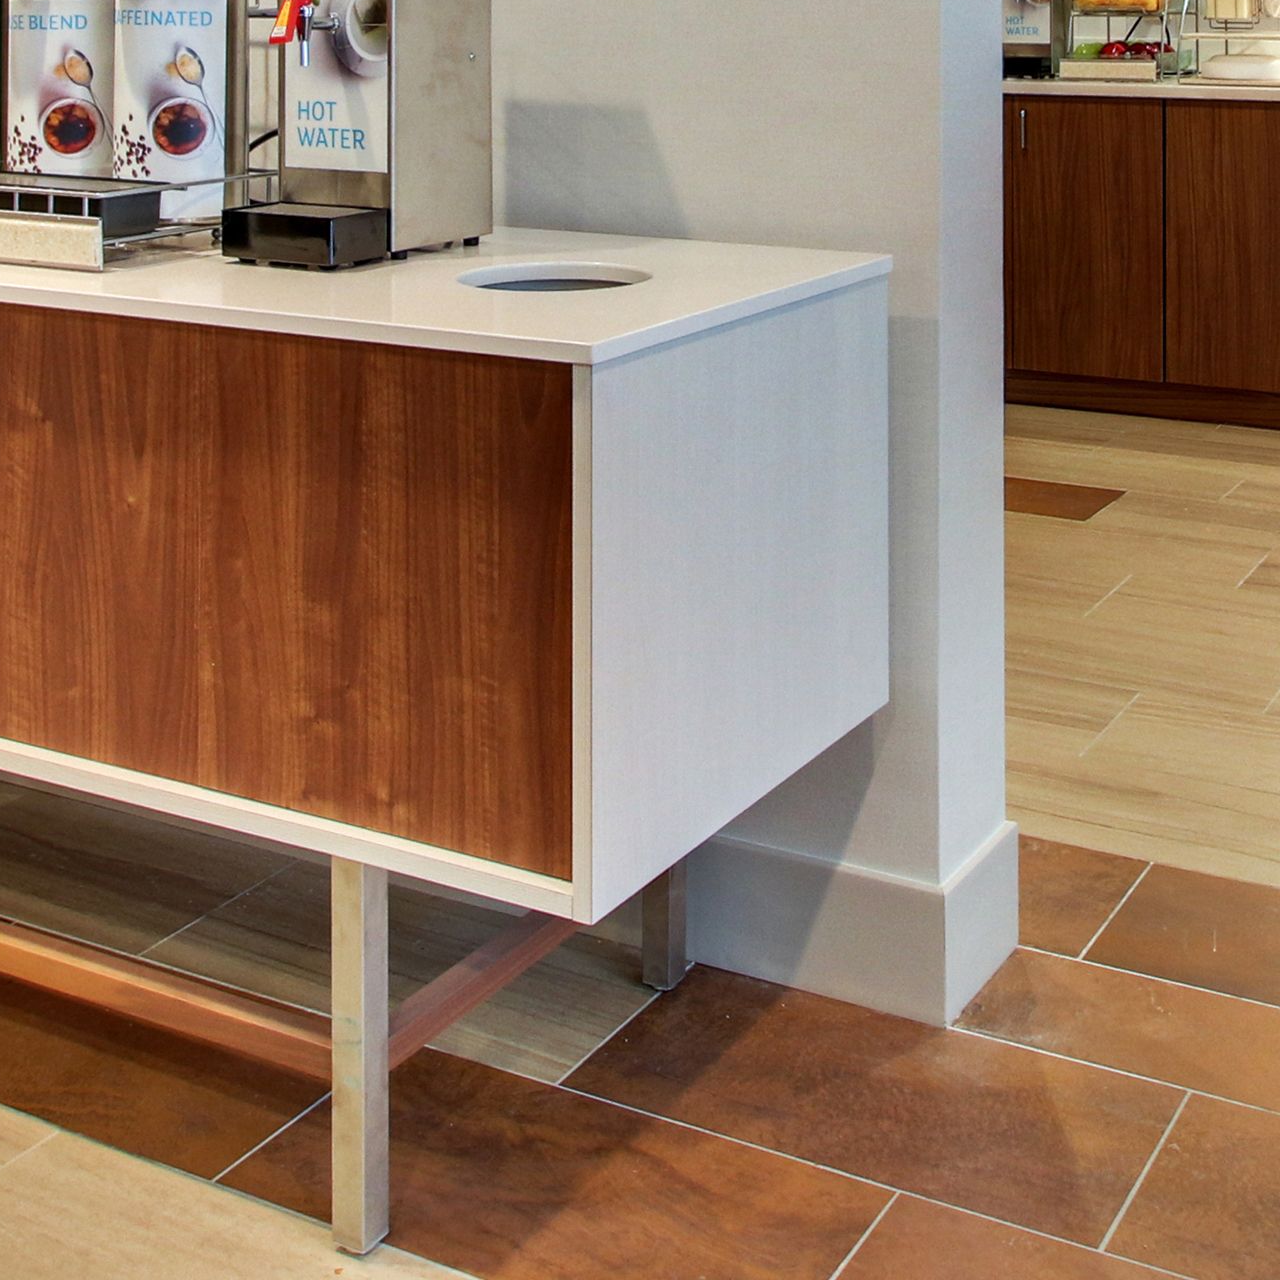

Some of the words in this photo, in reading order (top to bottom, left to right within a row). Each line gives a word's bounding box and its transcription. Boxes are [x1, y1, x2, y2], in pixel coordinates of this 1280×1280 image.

[28, 14, 88, 30] BLEND
[1005, 26, 1040, 36] WATER
[297, 100, 337, 121] HOT
[297, 126, 366, 150] WATER
